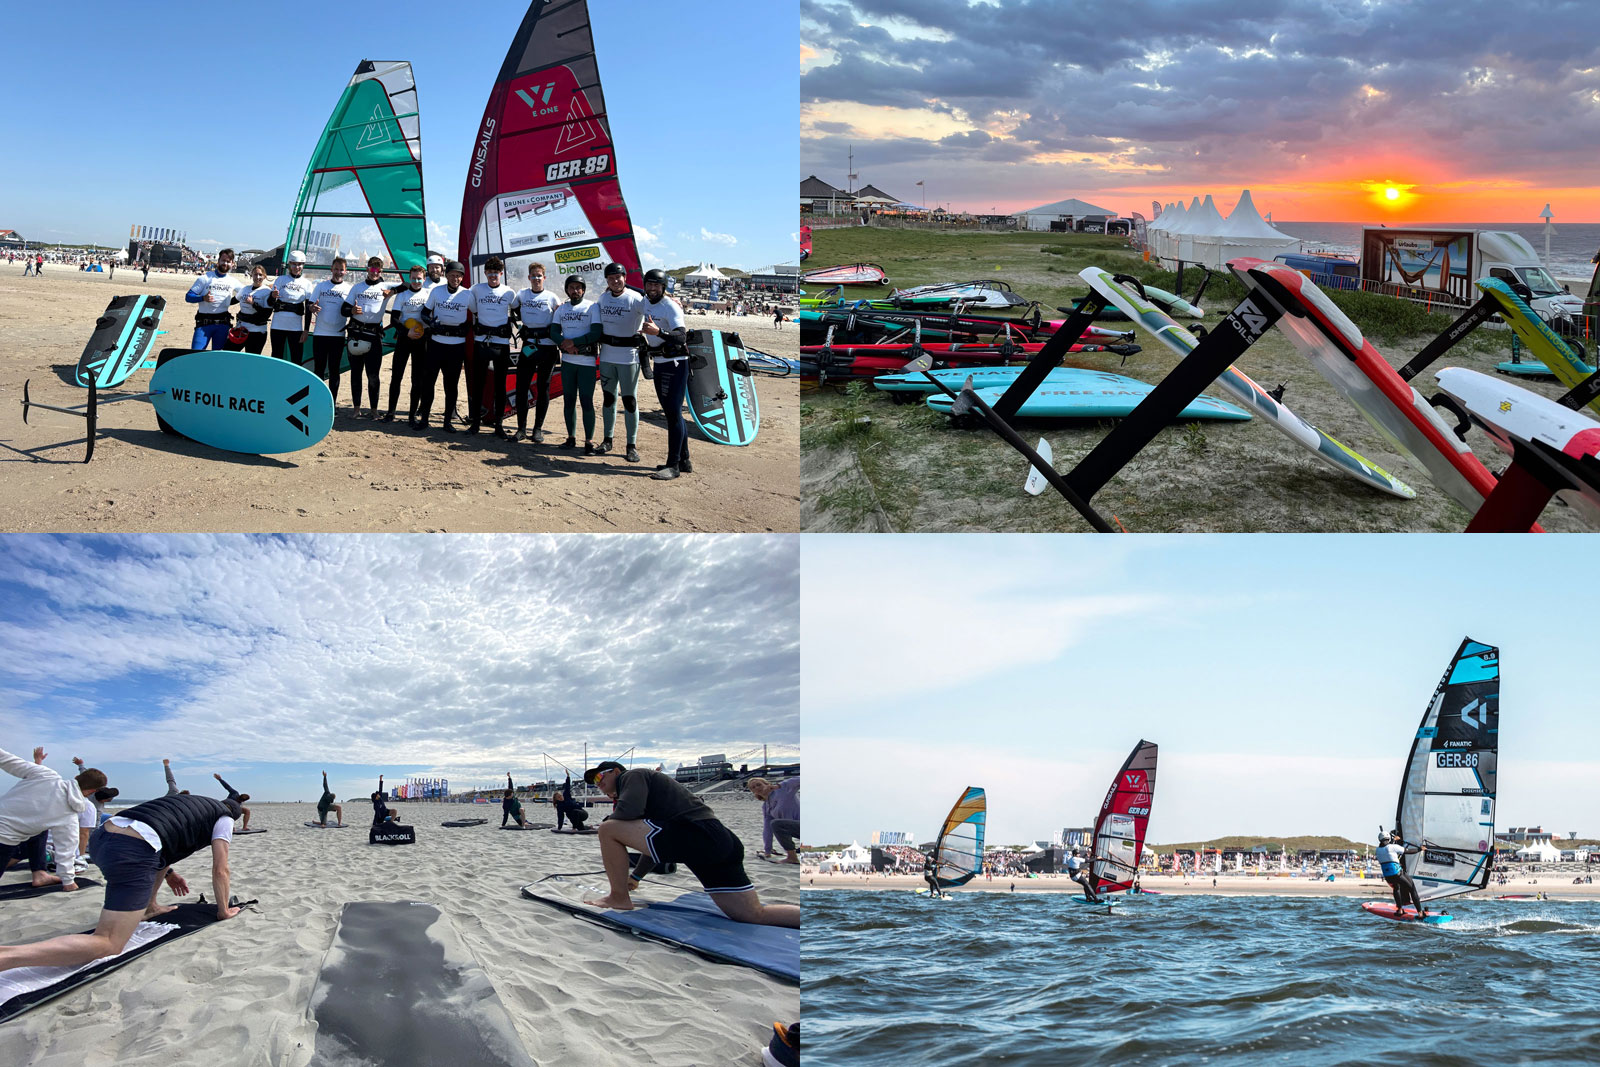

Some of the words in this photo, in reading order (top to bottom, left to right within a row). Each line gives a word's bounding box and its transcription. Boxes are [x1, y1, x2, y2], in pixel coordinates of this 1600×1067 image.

[540, 106, 559, 115] ONE
[472, 117, 496, 188] GUNSAILS
[546, 154, 608, 181] GER-89
[504, 200, 526, 208] BRUNE
[530, 193, 564, 203] COMPANY
[554, 229, 586, 238] KLEEMANN
[557, 248, 599, 261] RAPUNZEL
[1233, 297, 1268, 334] F4
[1226, 314, 1255, 344] FOILS
[1537, 321, 1578, 364] SLINGSHOT
[171, 387, 191, 403] WE
[194, 391, 225, 408] FOIL
[229, 396, 265, 414] RACE
[1483, 652, 1496, 660] 8.9
[1437, 753, 1479, 767] GER-86
